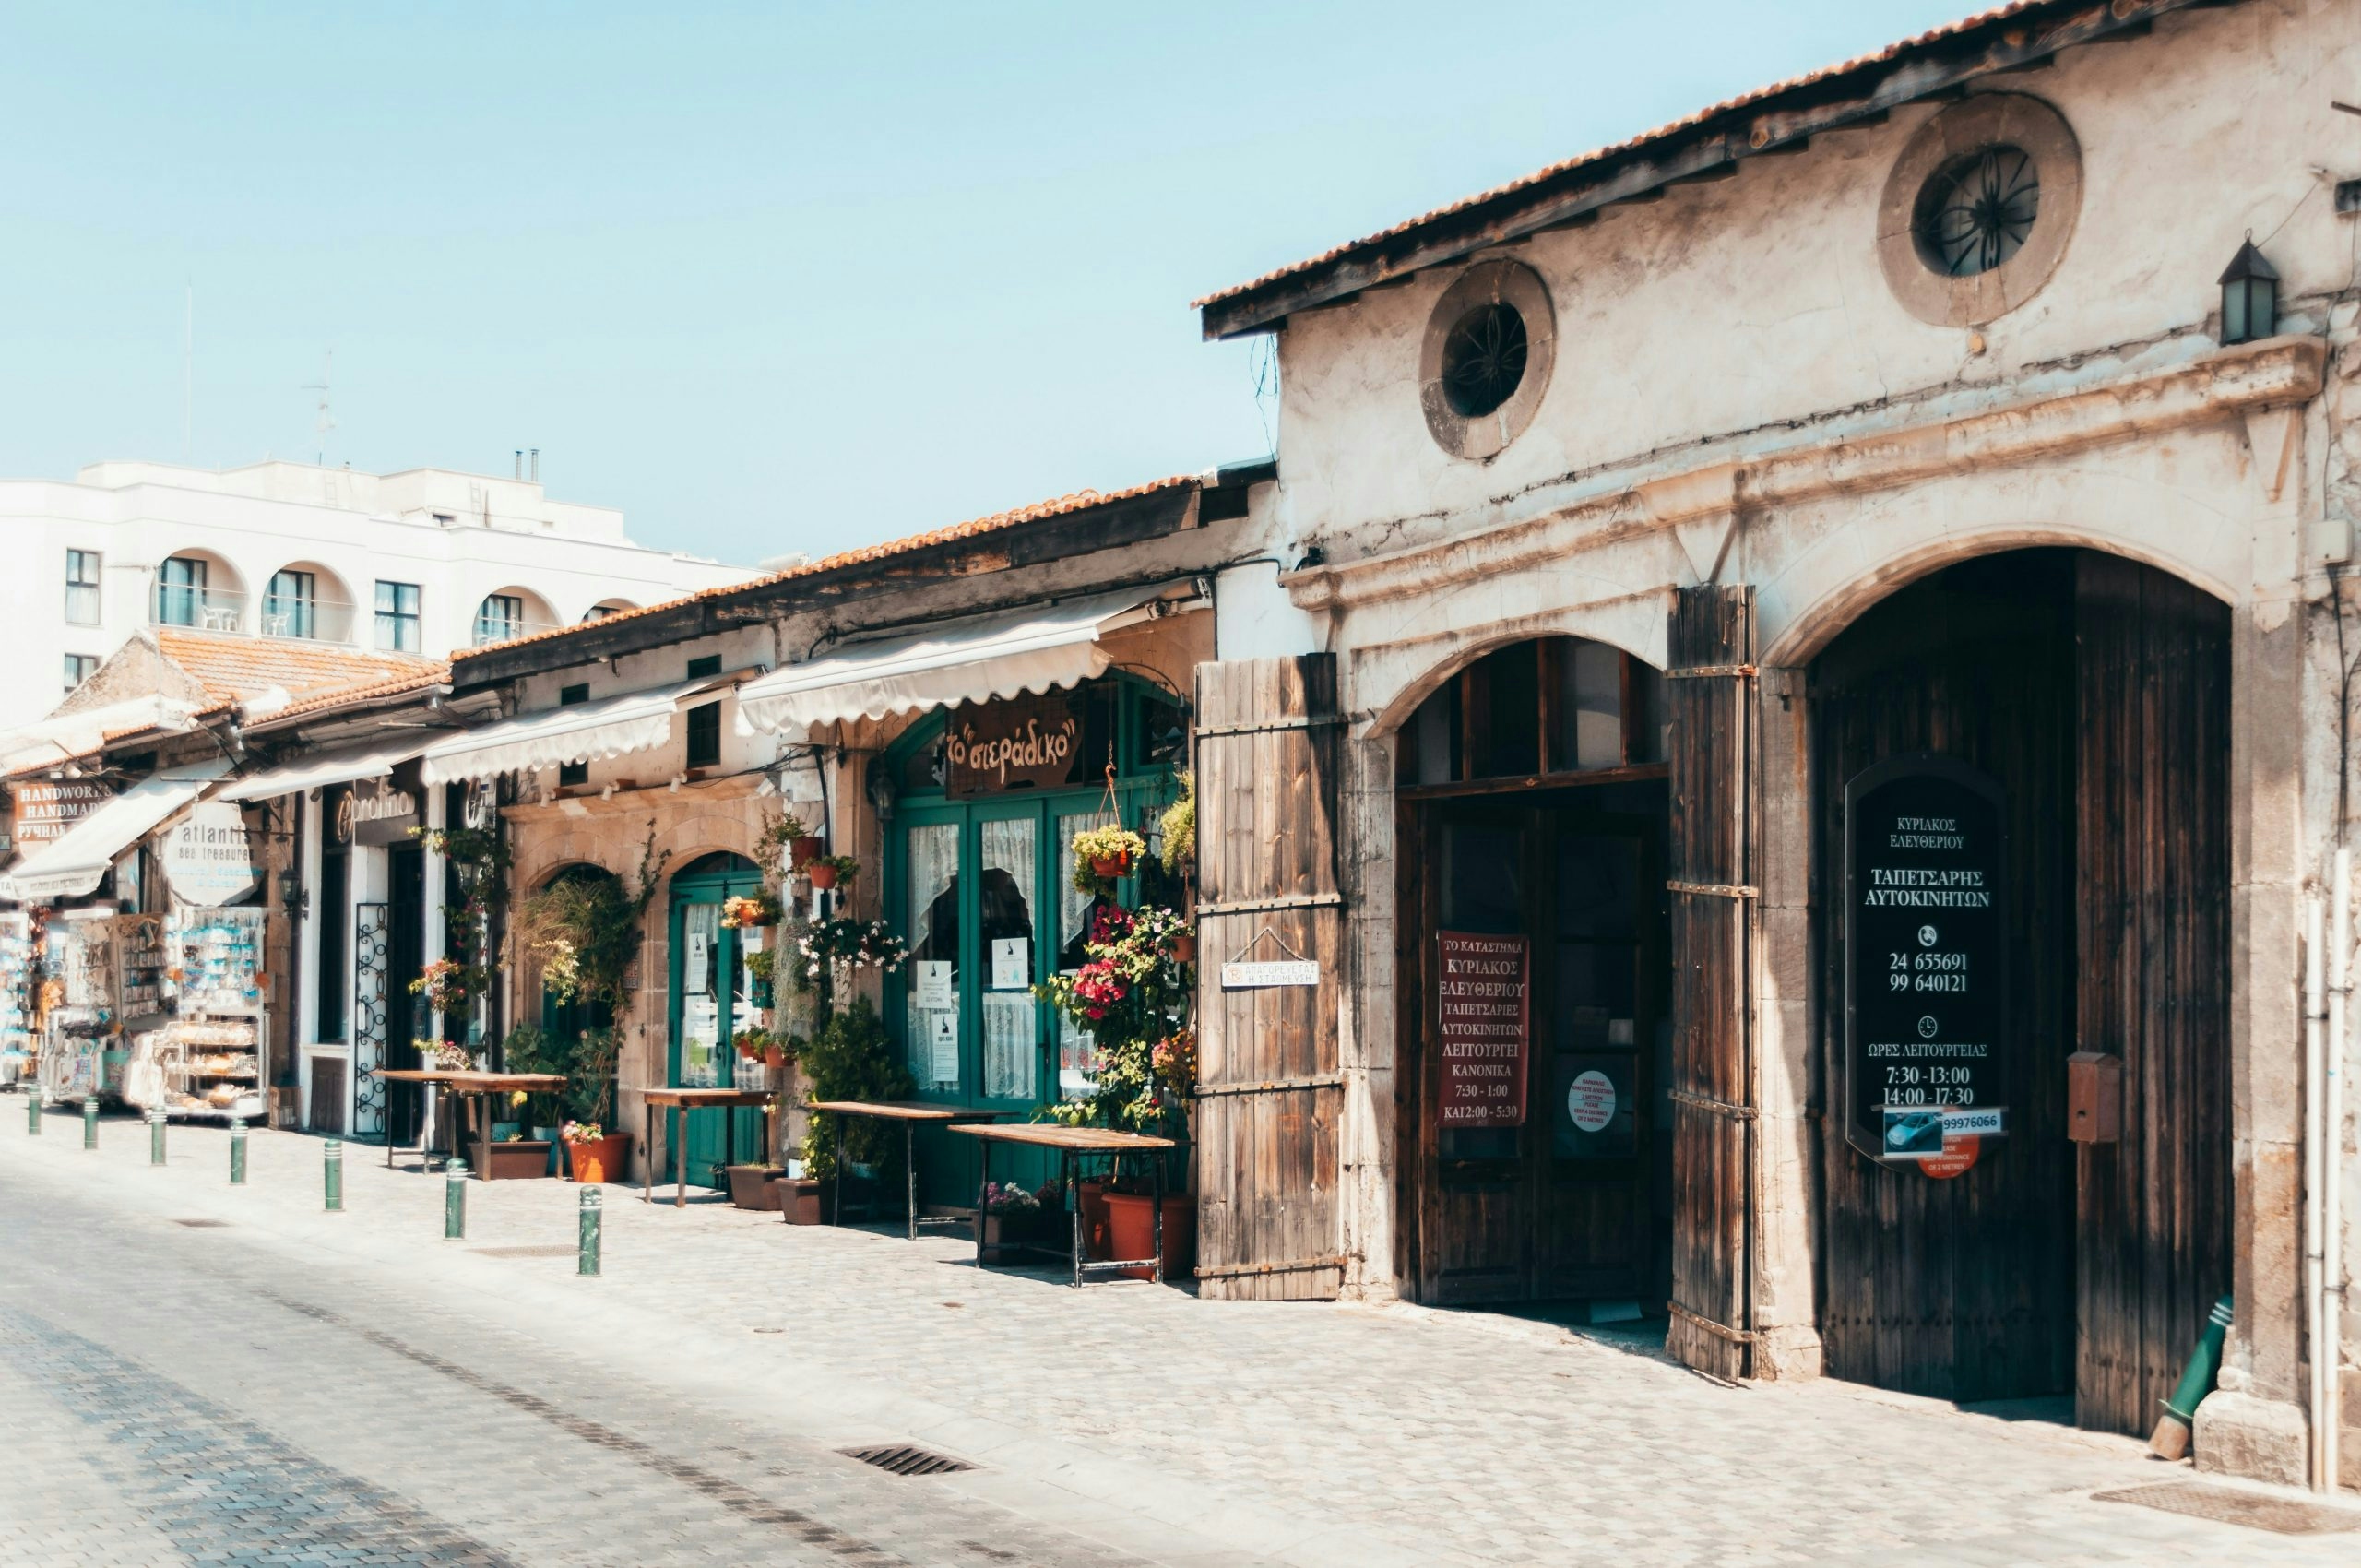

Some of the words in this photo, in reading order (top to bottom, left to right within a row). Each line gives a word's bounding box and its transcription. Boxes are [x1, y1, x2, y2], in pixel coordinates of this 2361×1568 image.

[1897, 817, 1956, 831] ΚΥΡΙΑΚΟΣ
[183, 824, 251, 845] atlantis
[1890, 834, 1964, 849] ΕΛΕΥΘΕΡΙΟΥ
[179, 847, 196, 860] sea
[203, 847, 255, 861] treasures
[1870, 869, 1984, 886] ΤΑΠΕΤΣΑΡΗΣ
[1864, 889, 1990, 908] ΑΥΤΟΚΙΝΗΤΩΝ
[1444, 940, 1459, 951] ΤΟ
[1461, 941, 1522, 953] ΚΑΤΑΣΤΗΜΑ
[1446, 959, 1518, 975] ΚΥΡΙΑΚΟΣ
[1889, 952, 1908, 970] 24
[1914, 953, 1967, 970] 655691
[1245, 963, 1316, 975] ΑΠΑΓΟΡΕΥΕΤΑΙ
[1441, 981, 1525, 997] ΕΛΕΥΘΕΡΙΟΥ
[1890, 973, 1909, 992] 99
[1914, 974, 1966, 992] 640121
[1444, 1004, 1519, 1016] ΤΑΠΕΤΣΑΡΙΕΣ
[1441, 1023, 1524, 1036] ΑΥΤΟΚΙΝΗΤΩΝ
[1442, 1043, 1519, 1057] ΛΕΙΤΟΥΡΓΕΙ
[1868, 1043, 1900, 1057] ΩΡΕΣ
[1902, 1043, 1988, 1057] ΛΕΙΤΟΥΡΓΕΙΑΣ
[1452, 1064, 1513, 1077] ΚΑΝΟΝΙΚΑ
[1886, 1066, 1919, 1084] 7:30
[1455, 1085, 1477, 1098] 7:30
[1487, 1085, 1508, 1097] 1:00
[1883, 1087, 1925, 1105] 14:00
[1443, 1106, 1464, 1119] ΚΑΙ
[1465, 1105, 1488, 1118] 2:00
[1495, 1105, 1517, 1118] 5:30
[1943, 1115, 1998, 1130] 99976066
